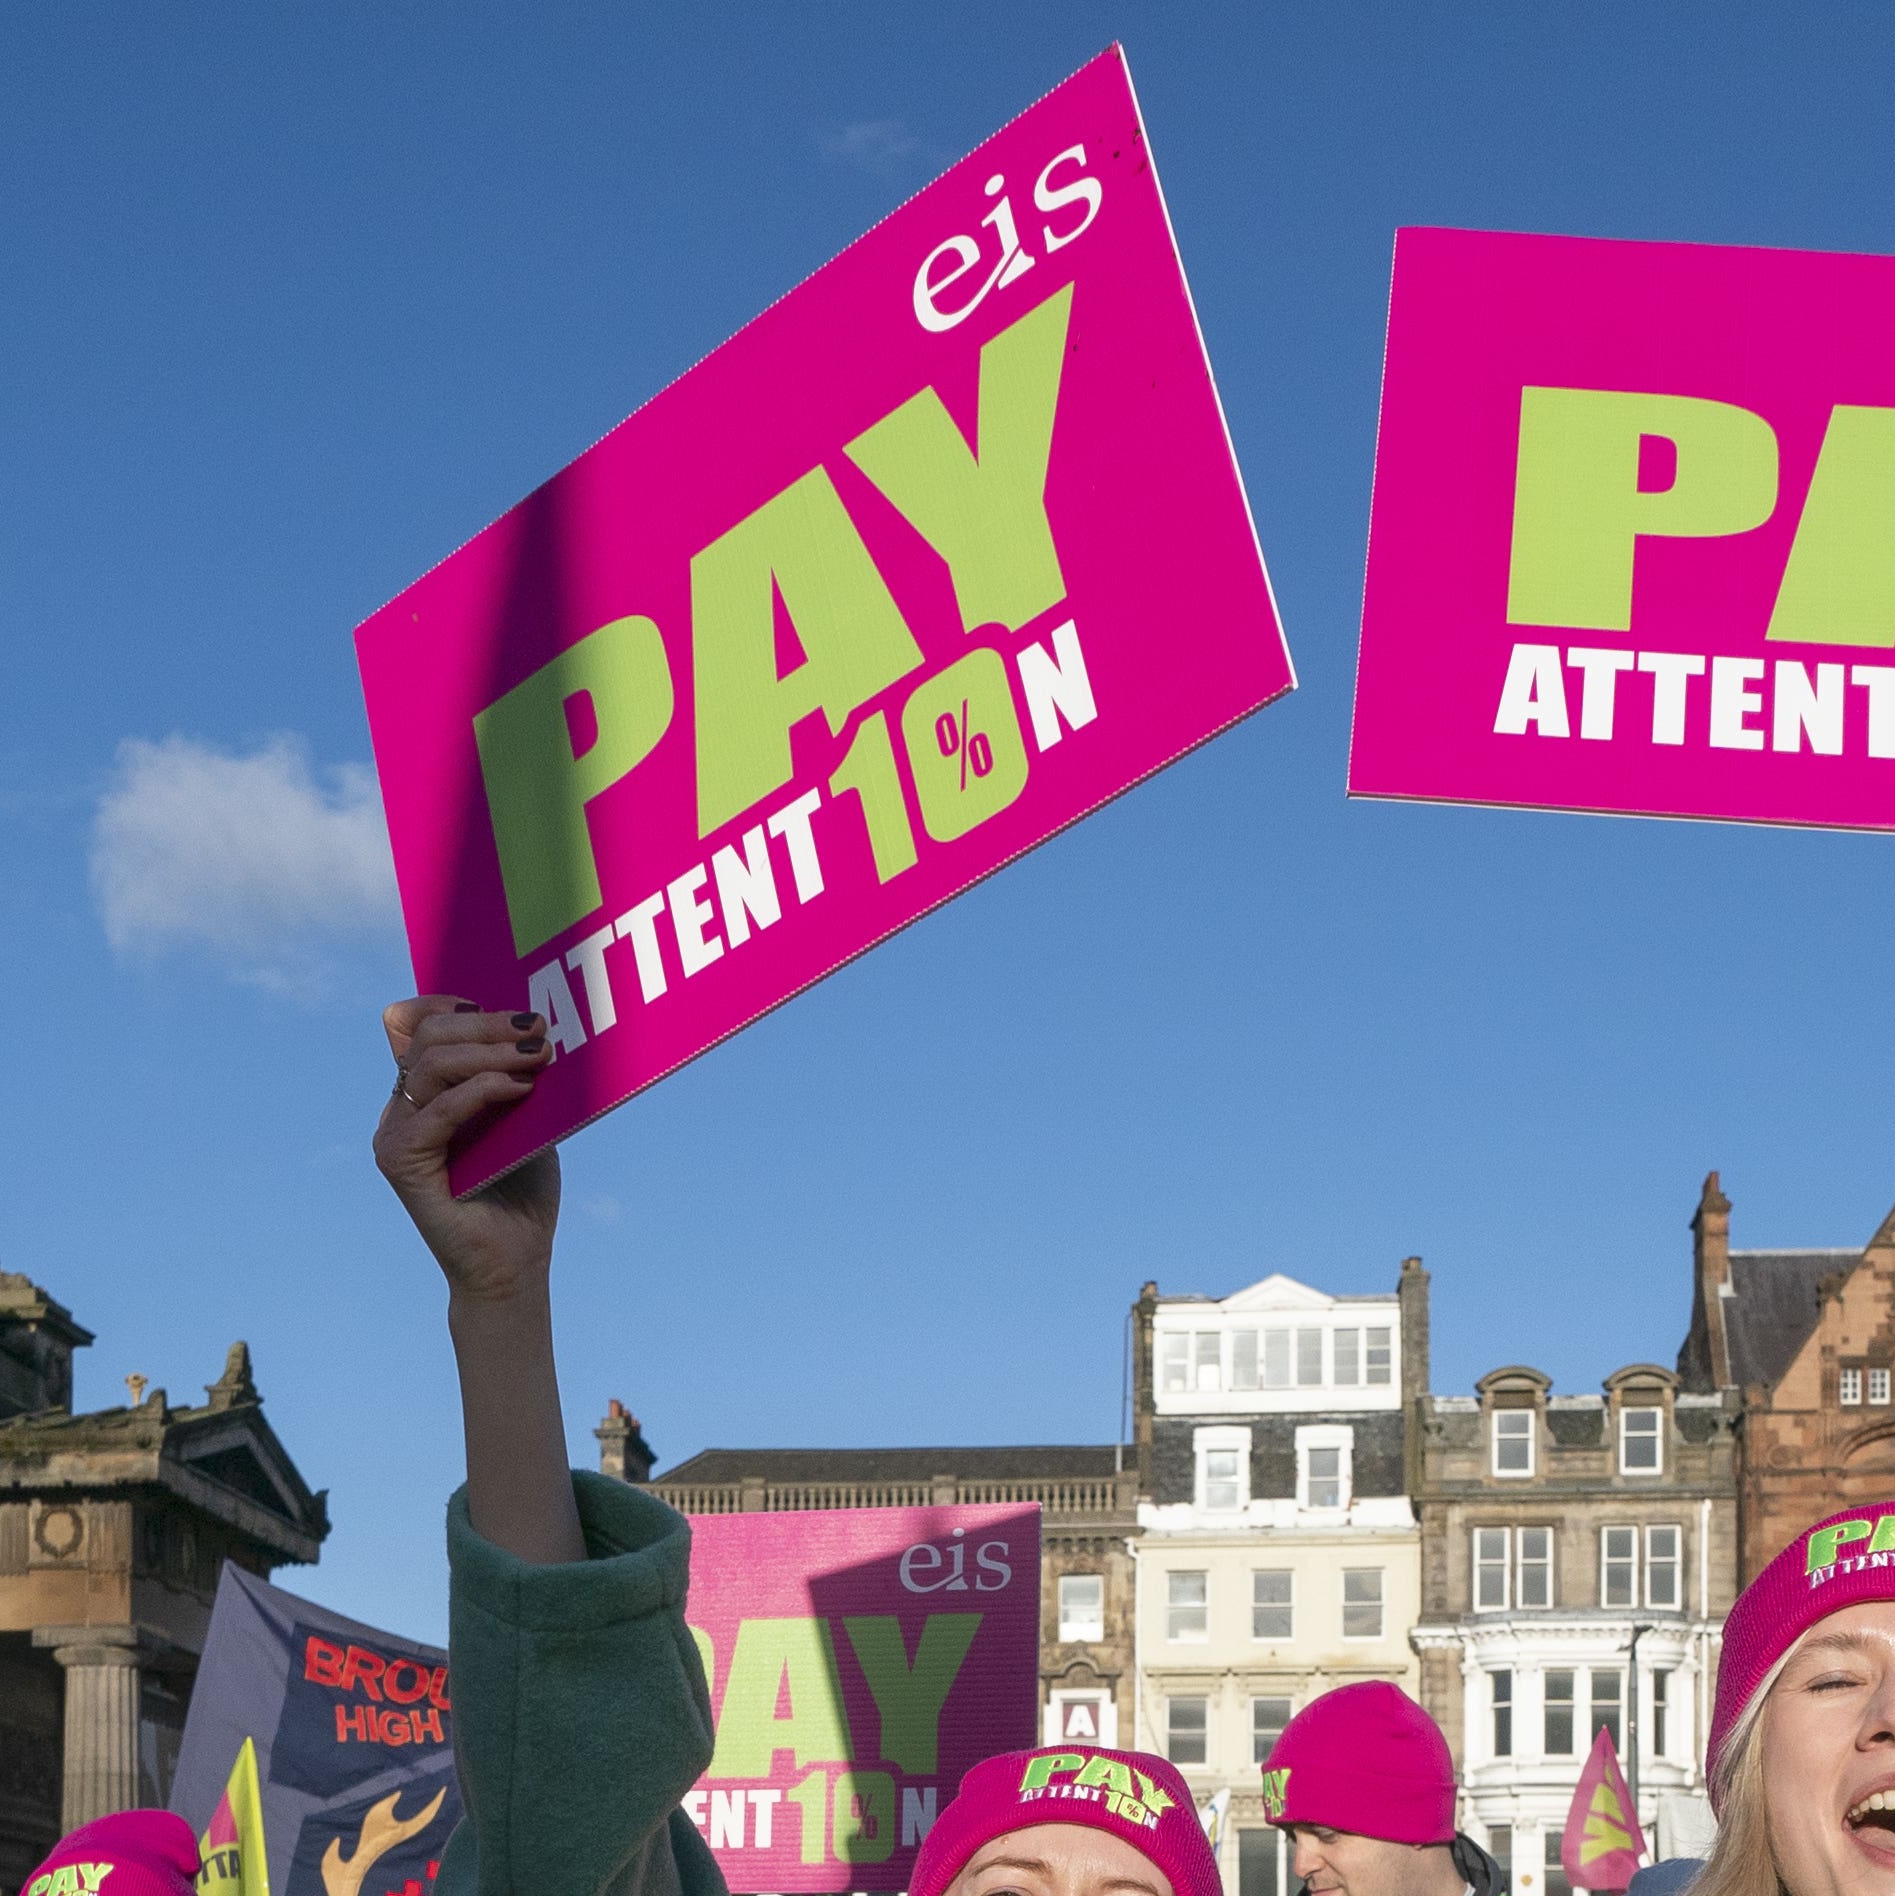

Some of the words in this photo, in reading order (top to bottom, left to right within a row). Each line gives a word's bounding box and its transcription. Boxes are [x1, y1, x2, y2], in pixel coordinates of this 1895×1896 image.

[912, 143, 1103, 334] eis
[472, 280, 1075, 960] PAY
[899, 1528, 1012, 1594] eis
[335, 1705, 444, 1746] HIGH
[688, 1612, 984, 1779] AY
[1065, 1706, 1097, 1737] A
[1018, 1753, 1176, 1815] PAY
